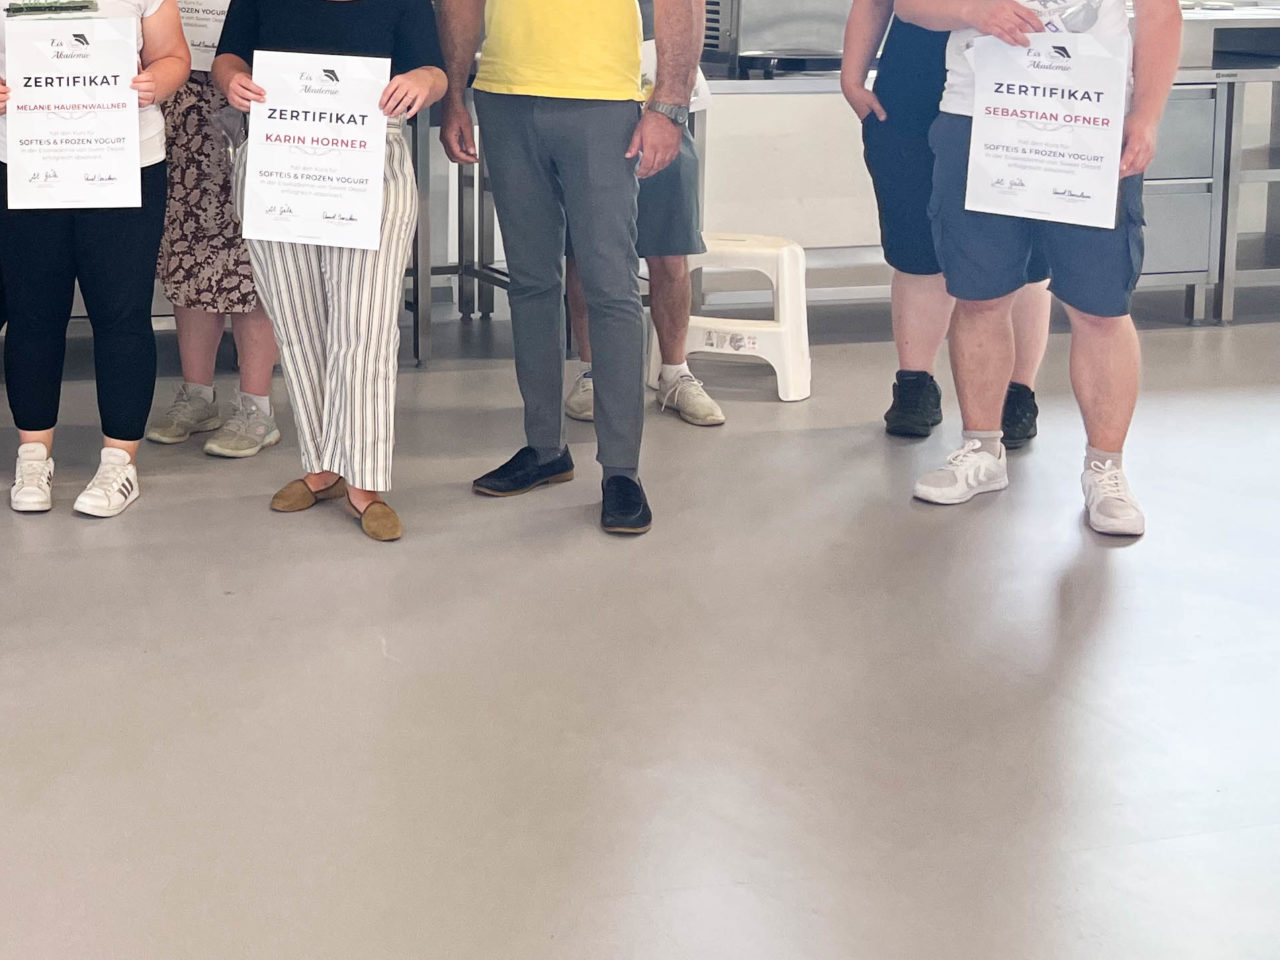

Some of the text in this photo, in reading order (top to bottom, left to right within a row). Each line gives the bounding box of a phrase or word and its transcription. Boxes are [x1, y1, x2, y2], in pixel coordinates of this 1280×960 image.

[23, 74, 120, 88] ZERTIFIKAT
[994, 82, 1104, 103] ZERTIFIKAT
[54, 102, 127, 111] HAUBENWALLNER
[267, 108, 368, 126] ZERTIFIKAT
[985, 106, 1110, 127] SEBASTIAN OFNER
[19, 138, 51, 146] SOFTEIS
[94, 137, 126, 145] YOGURT
[265, 133, 367, 149] KARIN HORNER
[984, 143, 1019, 153] SOFTEIS
[1029, 149, 1065, 158] FROZEN
[1067, 152, 1104, 162] YOGURT
[259, 170, 291, 179] SOFTEIS
[301, 173, 333, 182] FROZEN
[336, 177, 369, 185] YOGURT
